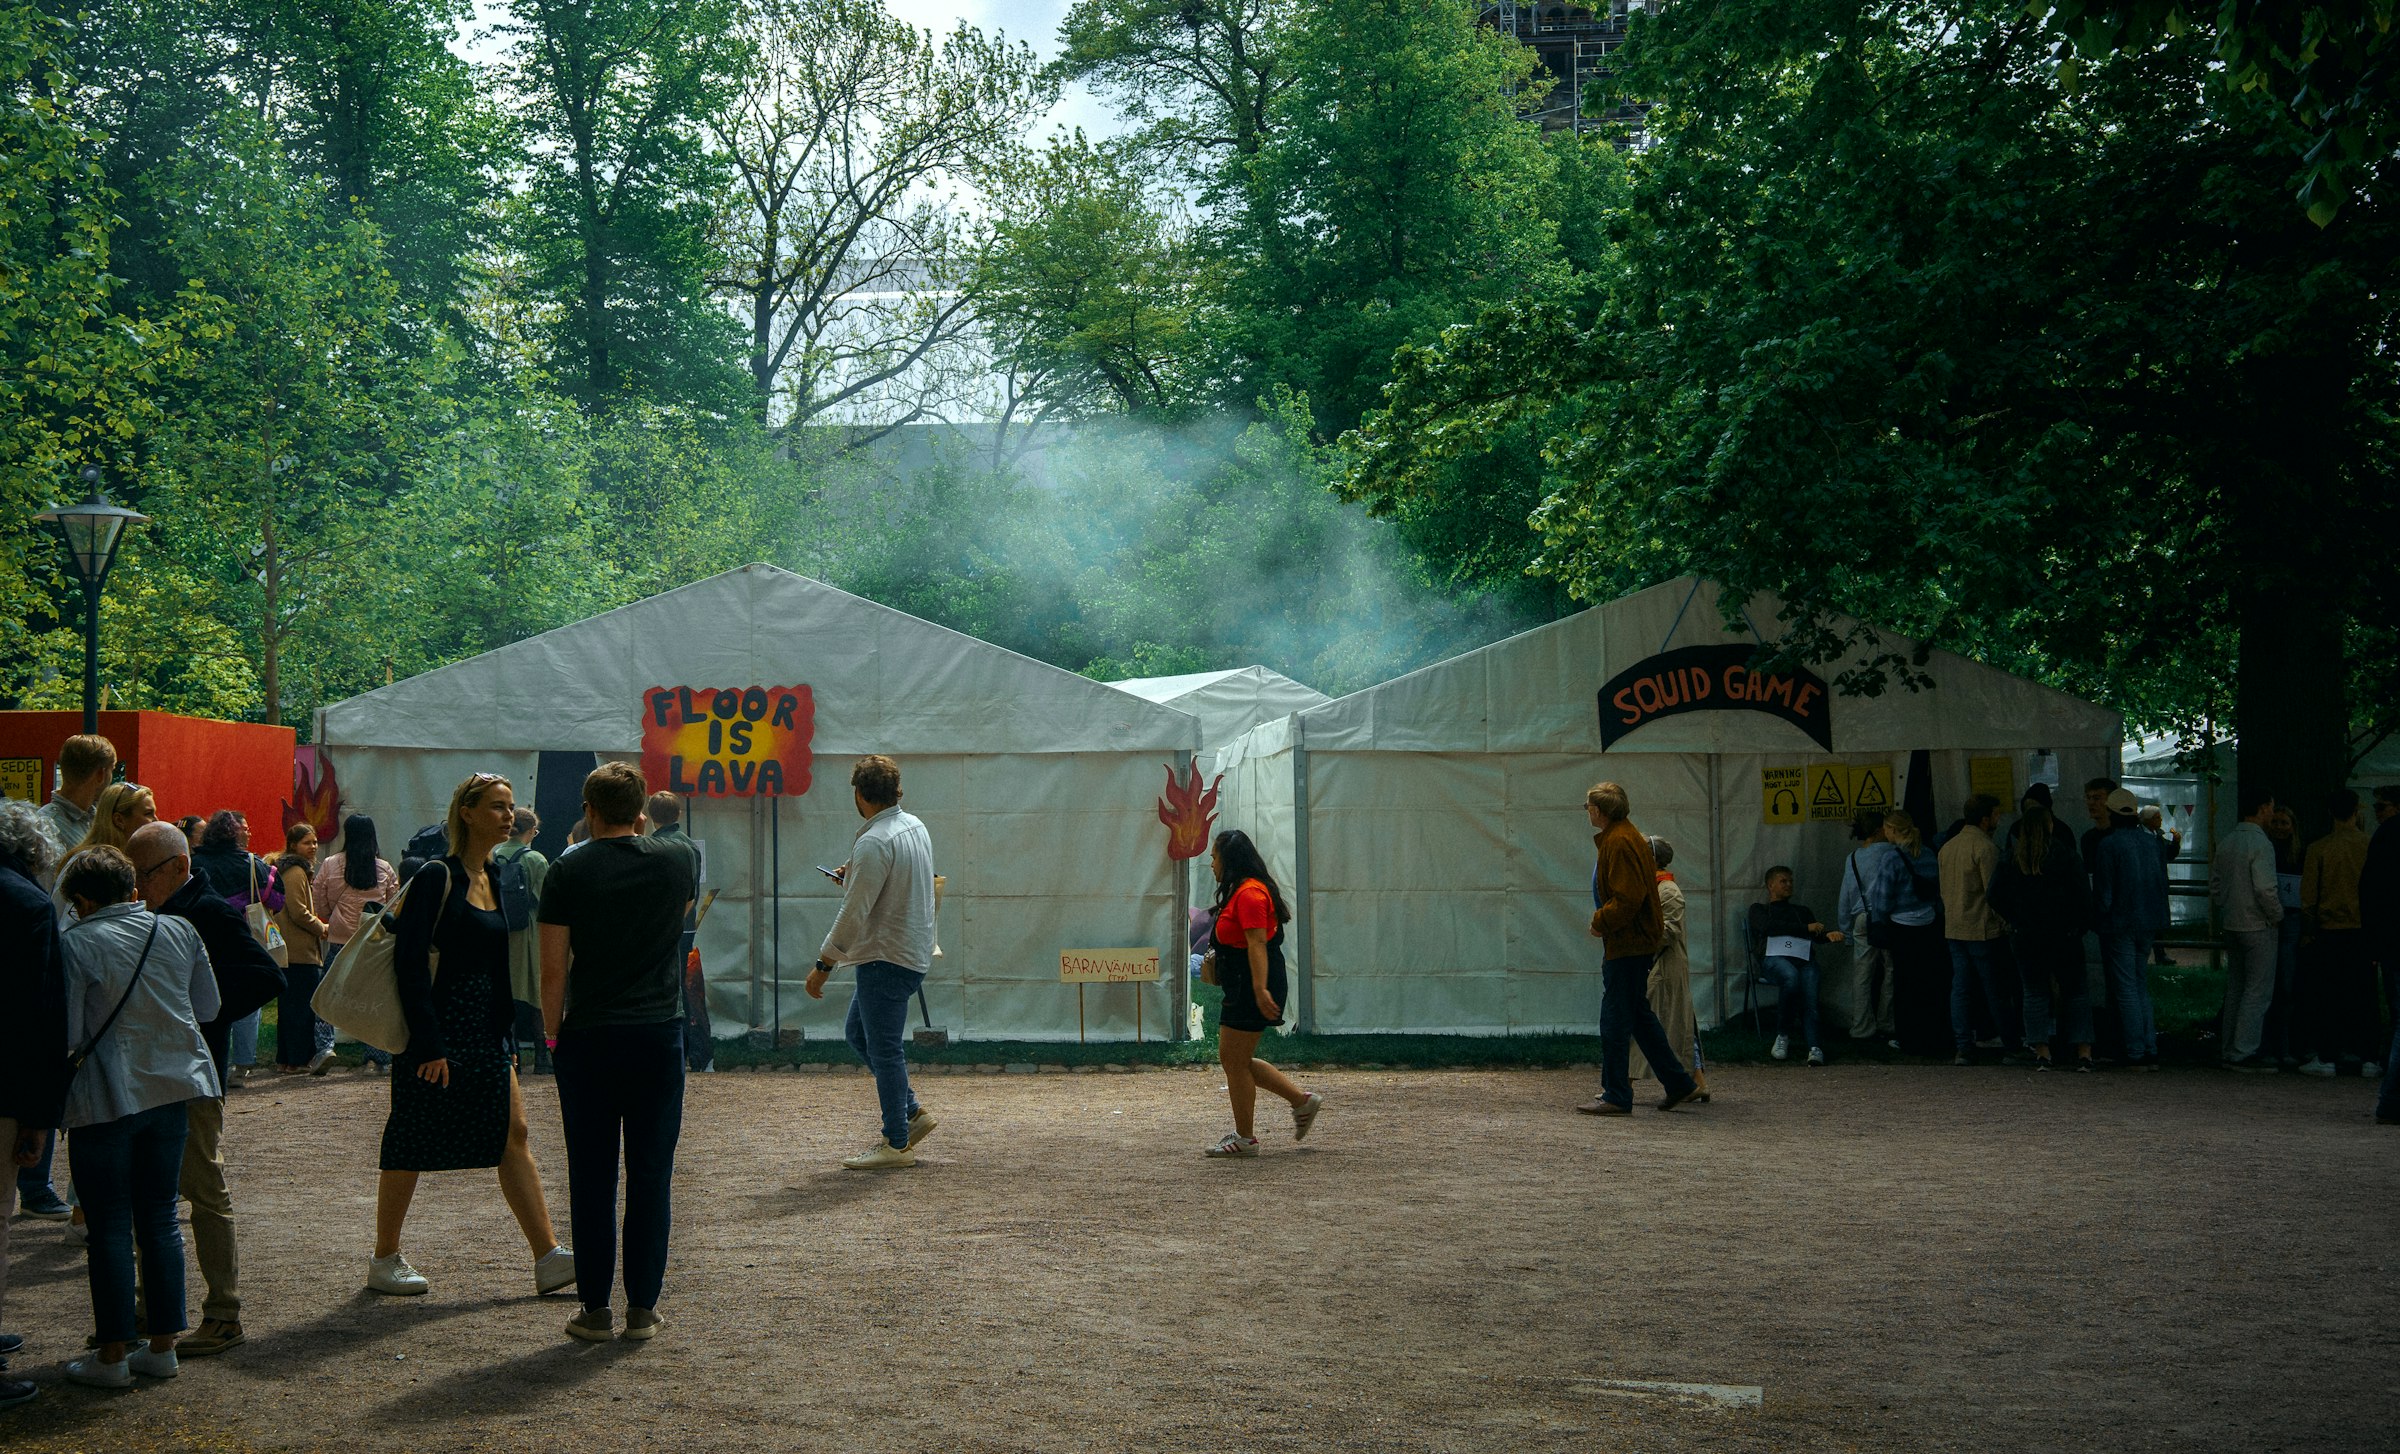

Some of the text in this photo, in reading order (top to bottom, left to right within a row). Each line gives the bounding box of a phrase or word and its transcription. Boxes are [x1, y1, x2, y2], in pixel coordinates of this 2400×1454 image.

[652, 685, 799, 731] FLOOR
[1612, 665, 1822, 726] SQUID GAME
[708, 719, 754, 756] IS
[669, 755, 784, 794] LAVA
[1784, 940, 1792, 949] 8
[1061, 956, 1160, 975] BARNVÄNLIGT
